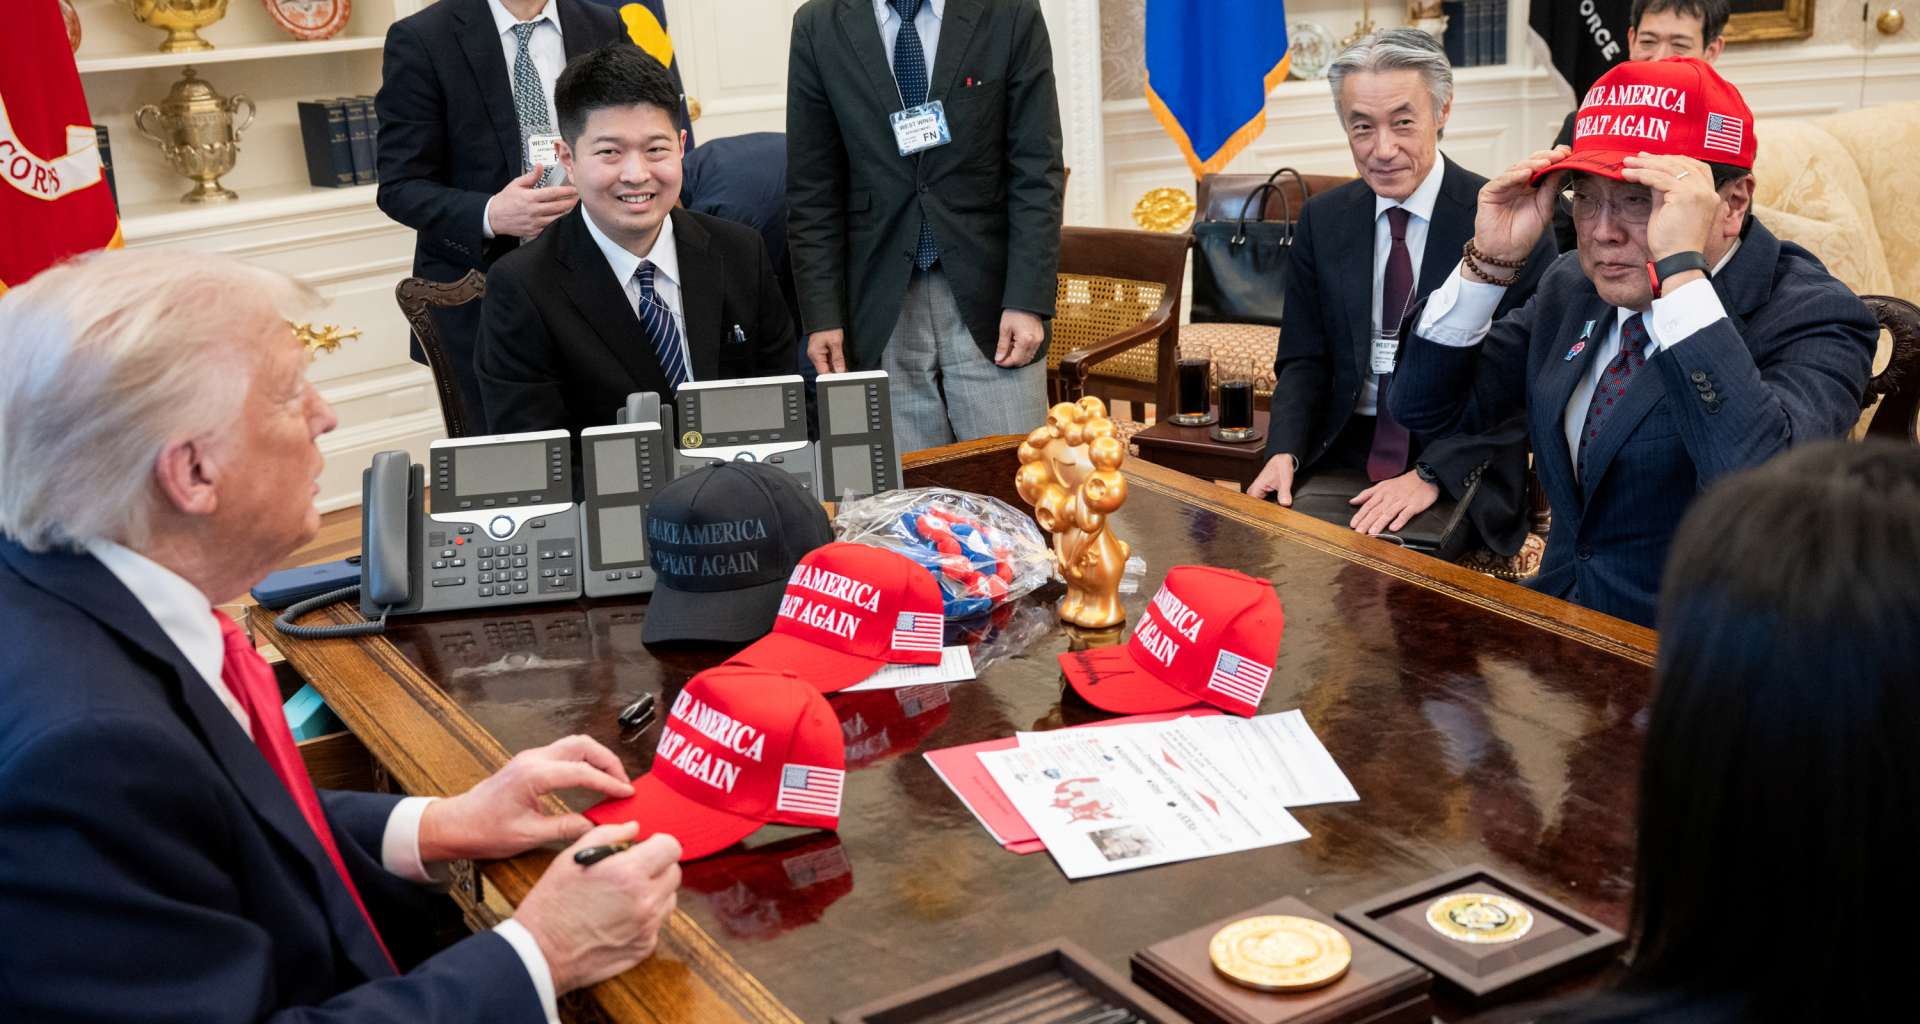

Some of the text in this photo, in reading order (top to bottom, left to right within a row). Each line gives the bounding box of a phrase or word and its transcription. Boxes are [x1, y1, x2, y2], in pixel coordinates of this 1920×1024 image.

[1604, 84, 1686, 114] AMERICA
[923, 131, 938, 142] FN
[1608, 114, 1670, 142] AGAIN
[682, 518, 768, 545] AMERICA
[701, 550, 760, 577] AGAIN
[800, 565, 881, 613] AMERICA
[797, 600, 861, 640] AGAIN
[1137, 620, 1180, 667] AGAIN
[682, 699, 766, 762] AMERICA
[672, 742, 742, 793] AGAIN
